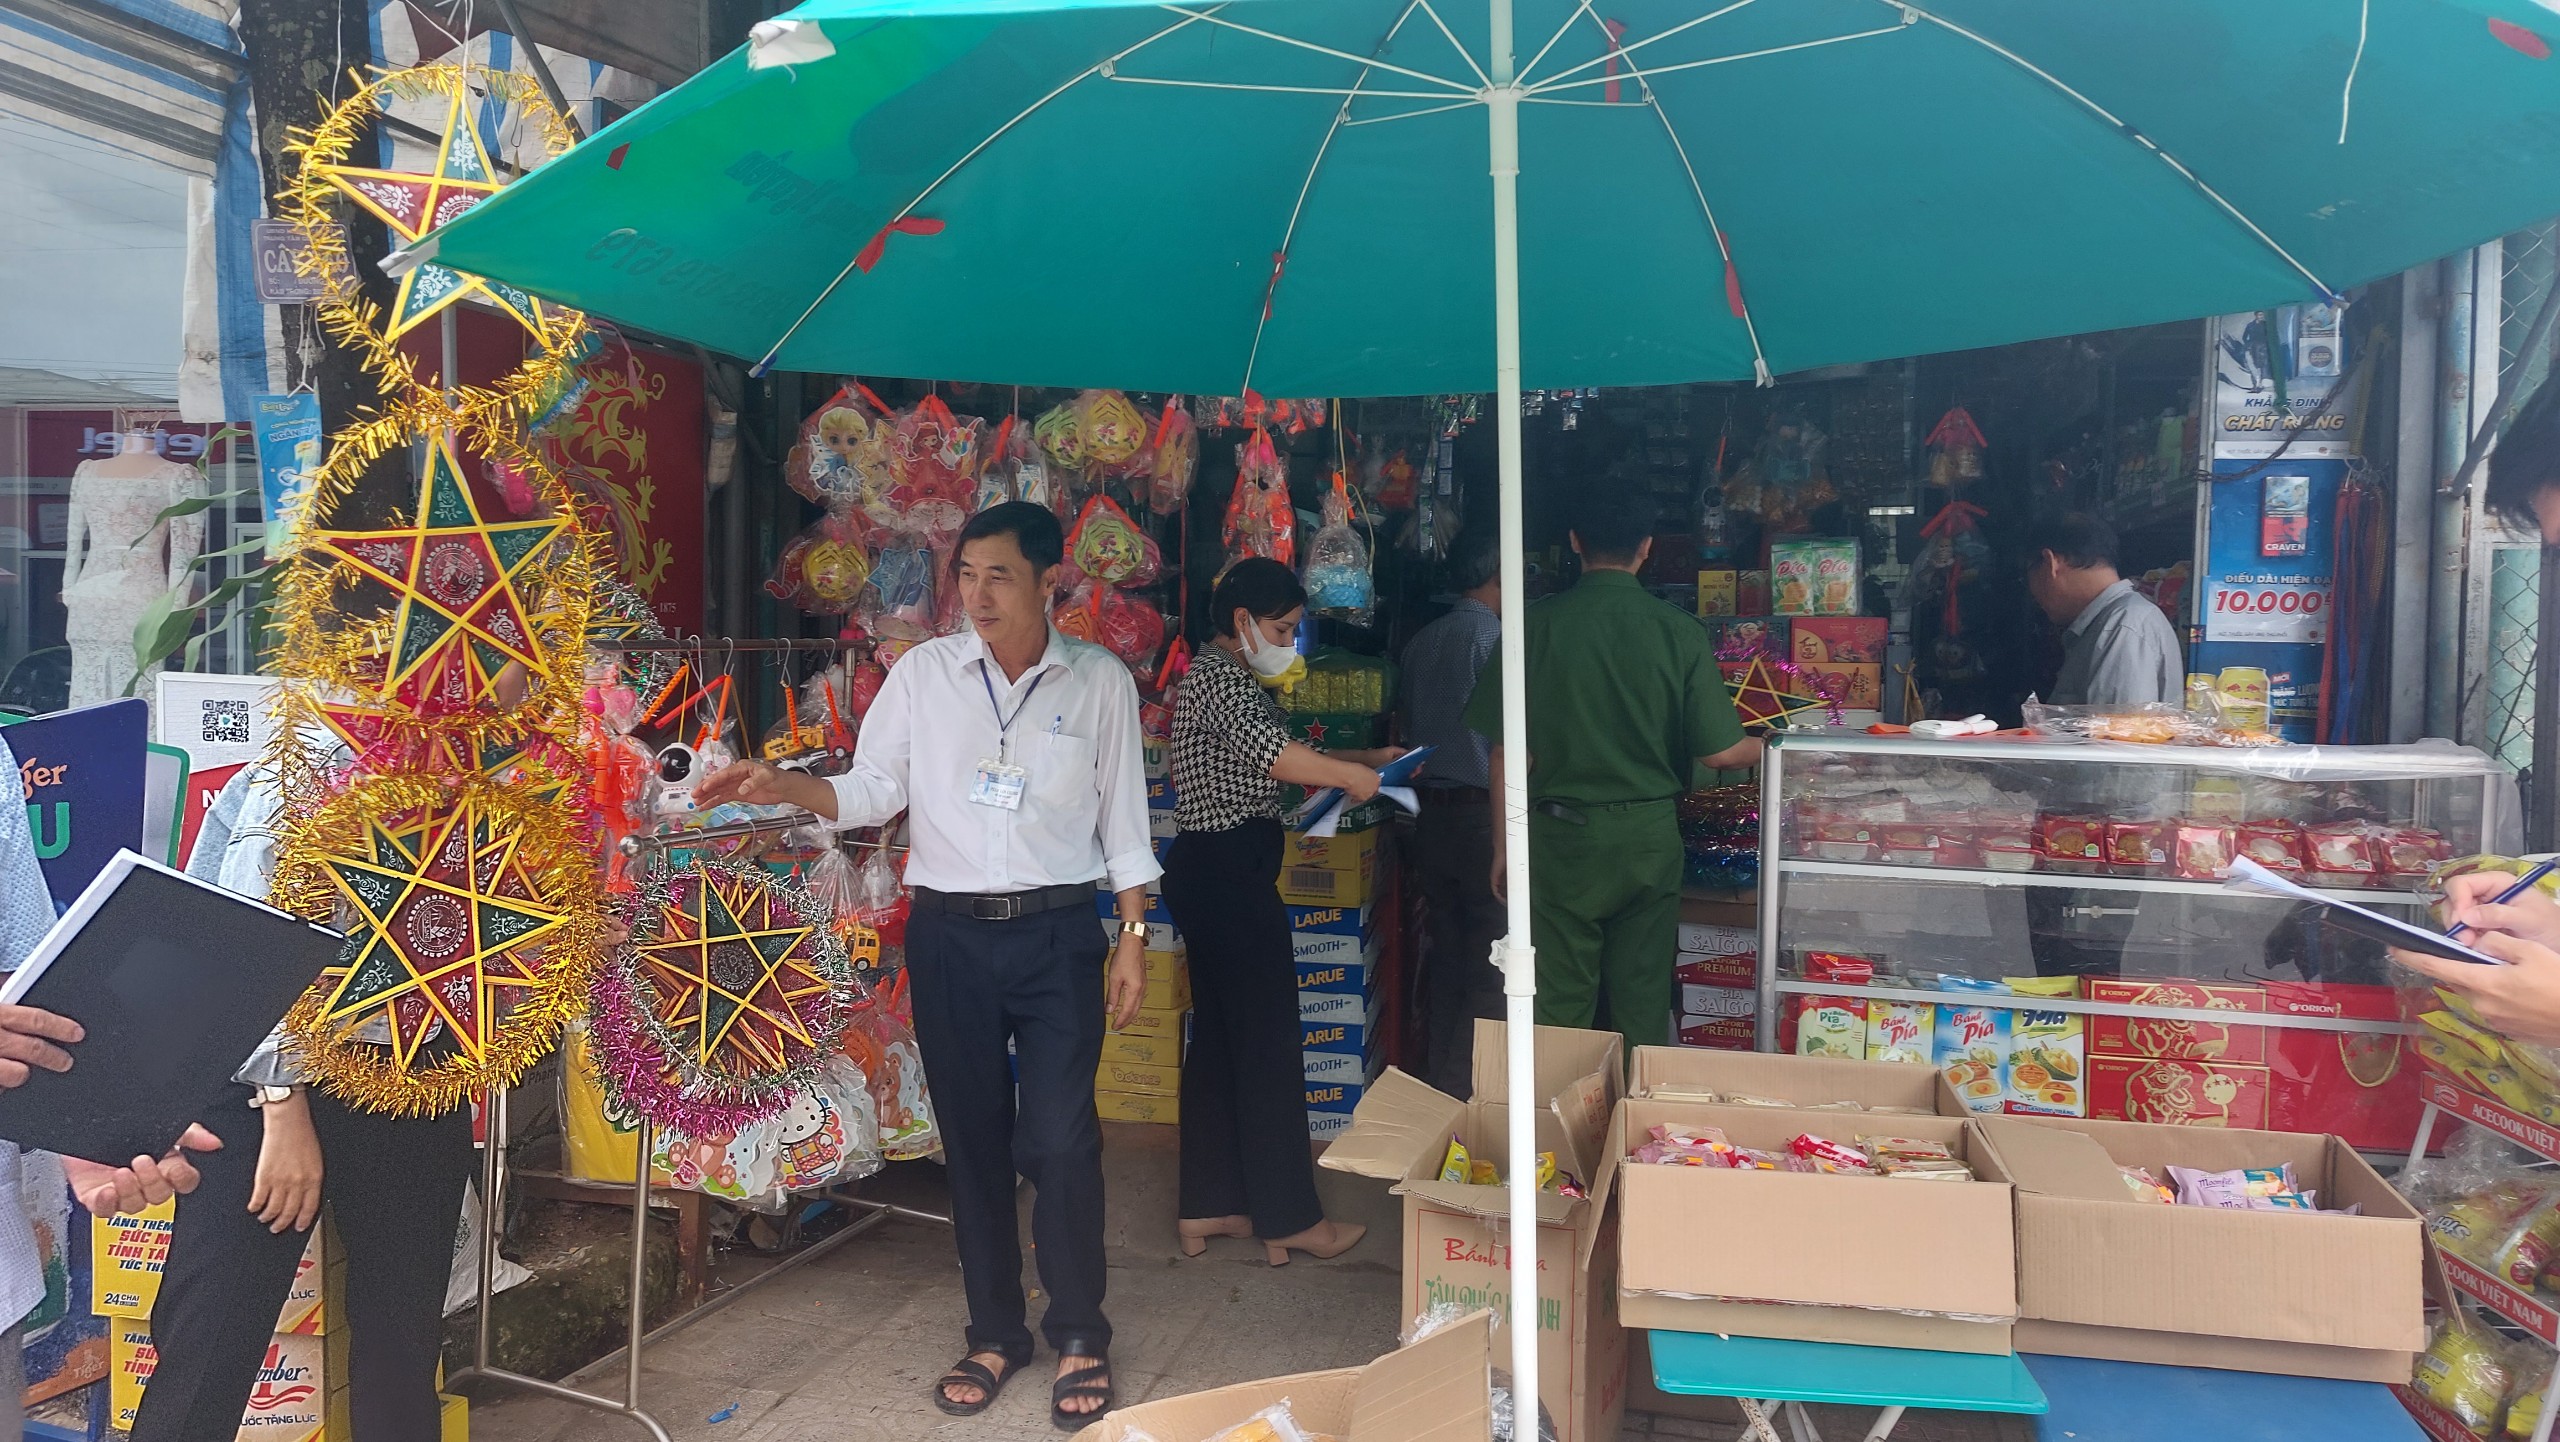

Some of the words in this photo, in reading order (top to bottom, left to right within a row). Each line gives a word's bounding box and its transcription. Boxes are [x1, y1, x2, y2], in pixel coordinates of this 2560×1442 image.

[2224, 411, 2279, 432] CHẤT
[2265, 543, 2306, 551] CRAVEN
[2256, 572, 2278, 584] DÀI
[2280, 574, 2310, 587] HIỆN
[660, 602, 677, 612] 1875
[1295, 907, 1342, 929] LARUE
[1716, 926, 1739, 938] BIA
[1293, 940, 1340, 957] SMOOTH
[1711, 956, 1741, 965] EXPORT
[1697, 962, 1751, 977] PREMIUM
[1297, 967, 1345, 988] LARUE
[1721, 988, 1744, 999] BIA
[2107, 989, 2132, 997] ORION
[1695, 996, 1755, 1016] SAIGO
[2300, 1003, 2335, 1013] ORION
[1715, 1020, 1745, 1028] EXPORT
[1880, 1015, 1907, 1030] Bánh
[1952, 1011, 1982, 1027] Bánh
[1701, 1025, 1755, 1038] PREMIUM
[1890, 1022, 1918, 1047] Pía
[1963, 1020, 1995, 1045] Pía
[1303, 1058, 1342, 1074] MOOTH
[1305, 1087, 1343, 1104] ARUE
[1310, 1118, 1341, 1132] OOTH
[2472, 1103, 2526, 1139] ACECOOK
[2526, 1126, 2556, 1153] VIỆT
[106, 1215, 140, 1229] TĂNG
[118, 1229, 153, 1243] SỨC
[147, 1246, 166, 1260] TÁ
[1443, 1237, 1498, 1268] Bánh
[103, 1292, 120, 1305] 24
[291, 1289, 316, 1300] LỰC
[2480, 1278, 2510, 1309] VIỆT
[2512, 1301, 2543, 1331] NAM
[119, 1408, 136, 1421] 24
[264, 1414, 294, 1425] TĂNG
[295, 1414, 317, 1425] LỰC
